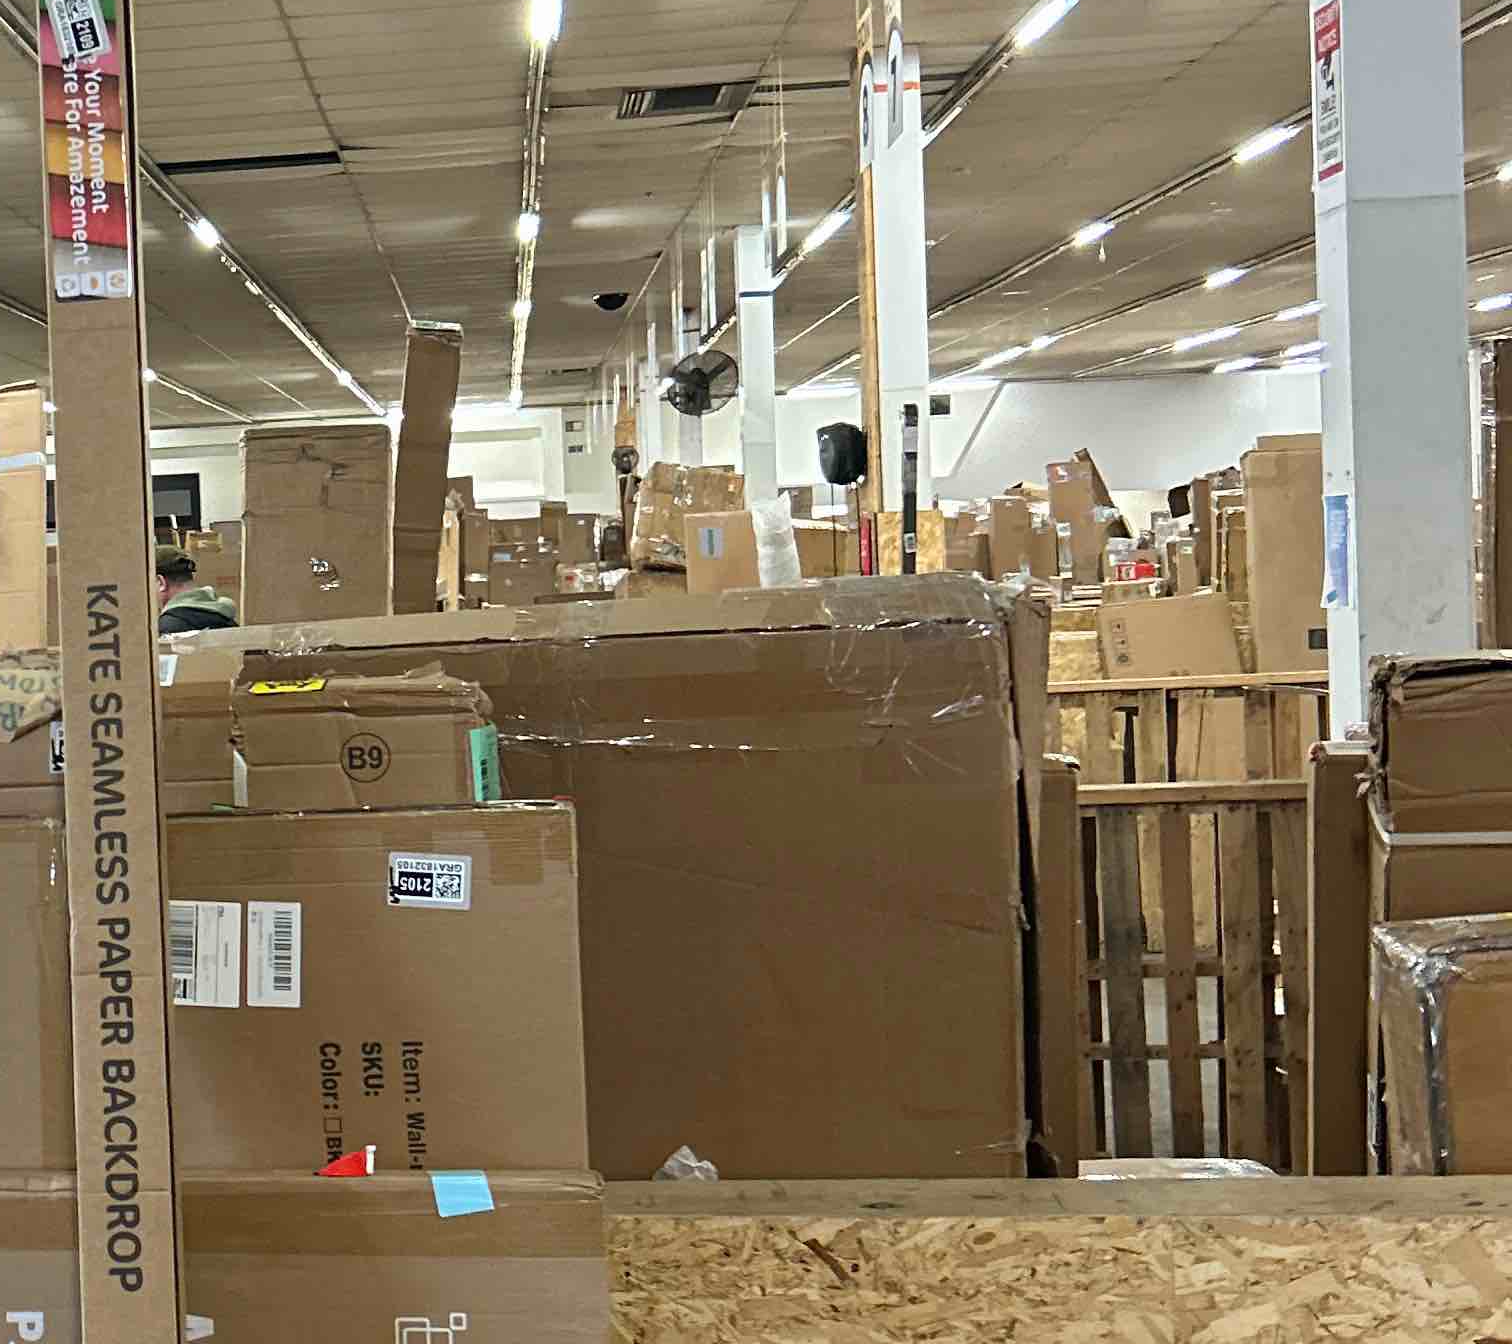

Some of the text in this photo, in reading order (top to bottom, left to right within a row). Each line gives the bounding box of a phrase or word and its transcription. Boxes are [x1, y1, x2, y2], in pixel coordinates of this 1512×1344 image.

[64, 98, 84, 130] For
[83, 68, 103, 118] Your
[862, 83, 870, 147] 8
[66, 135, 92, 266] Amazement
[87, 122, 110, 215] Moment
[347, 744, 384, 771] B9
[399, 876, 432, 892] 2105
[86, 583, 144, 1293] KATE SEAMLESS PAPER BACKDROP
[319, 1042, 343, 1111] Color:
[361, 1041, 385, 1097] SKU:
[401, 1040, 424, 1104] Item:
